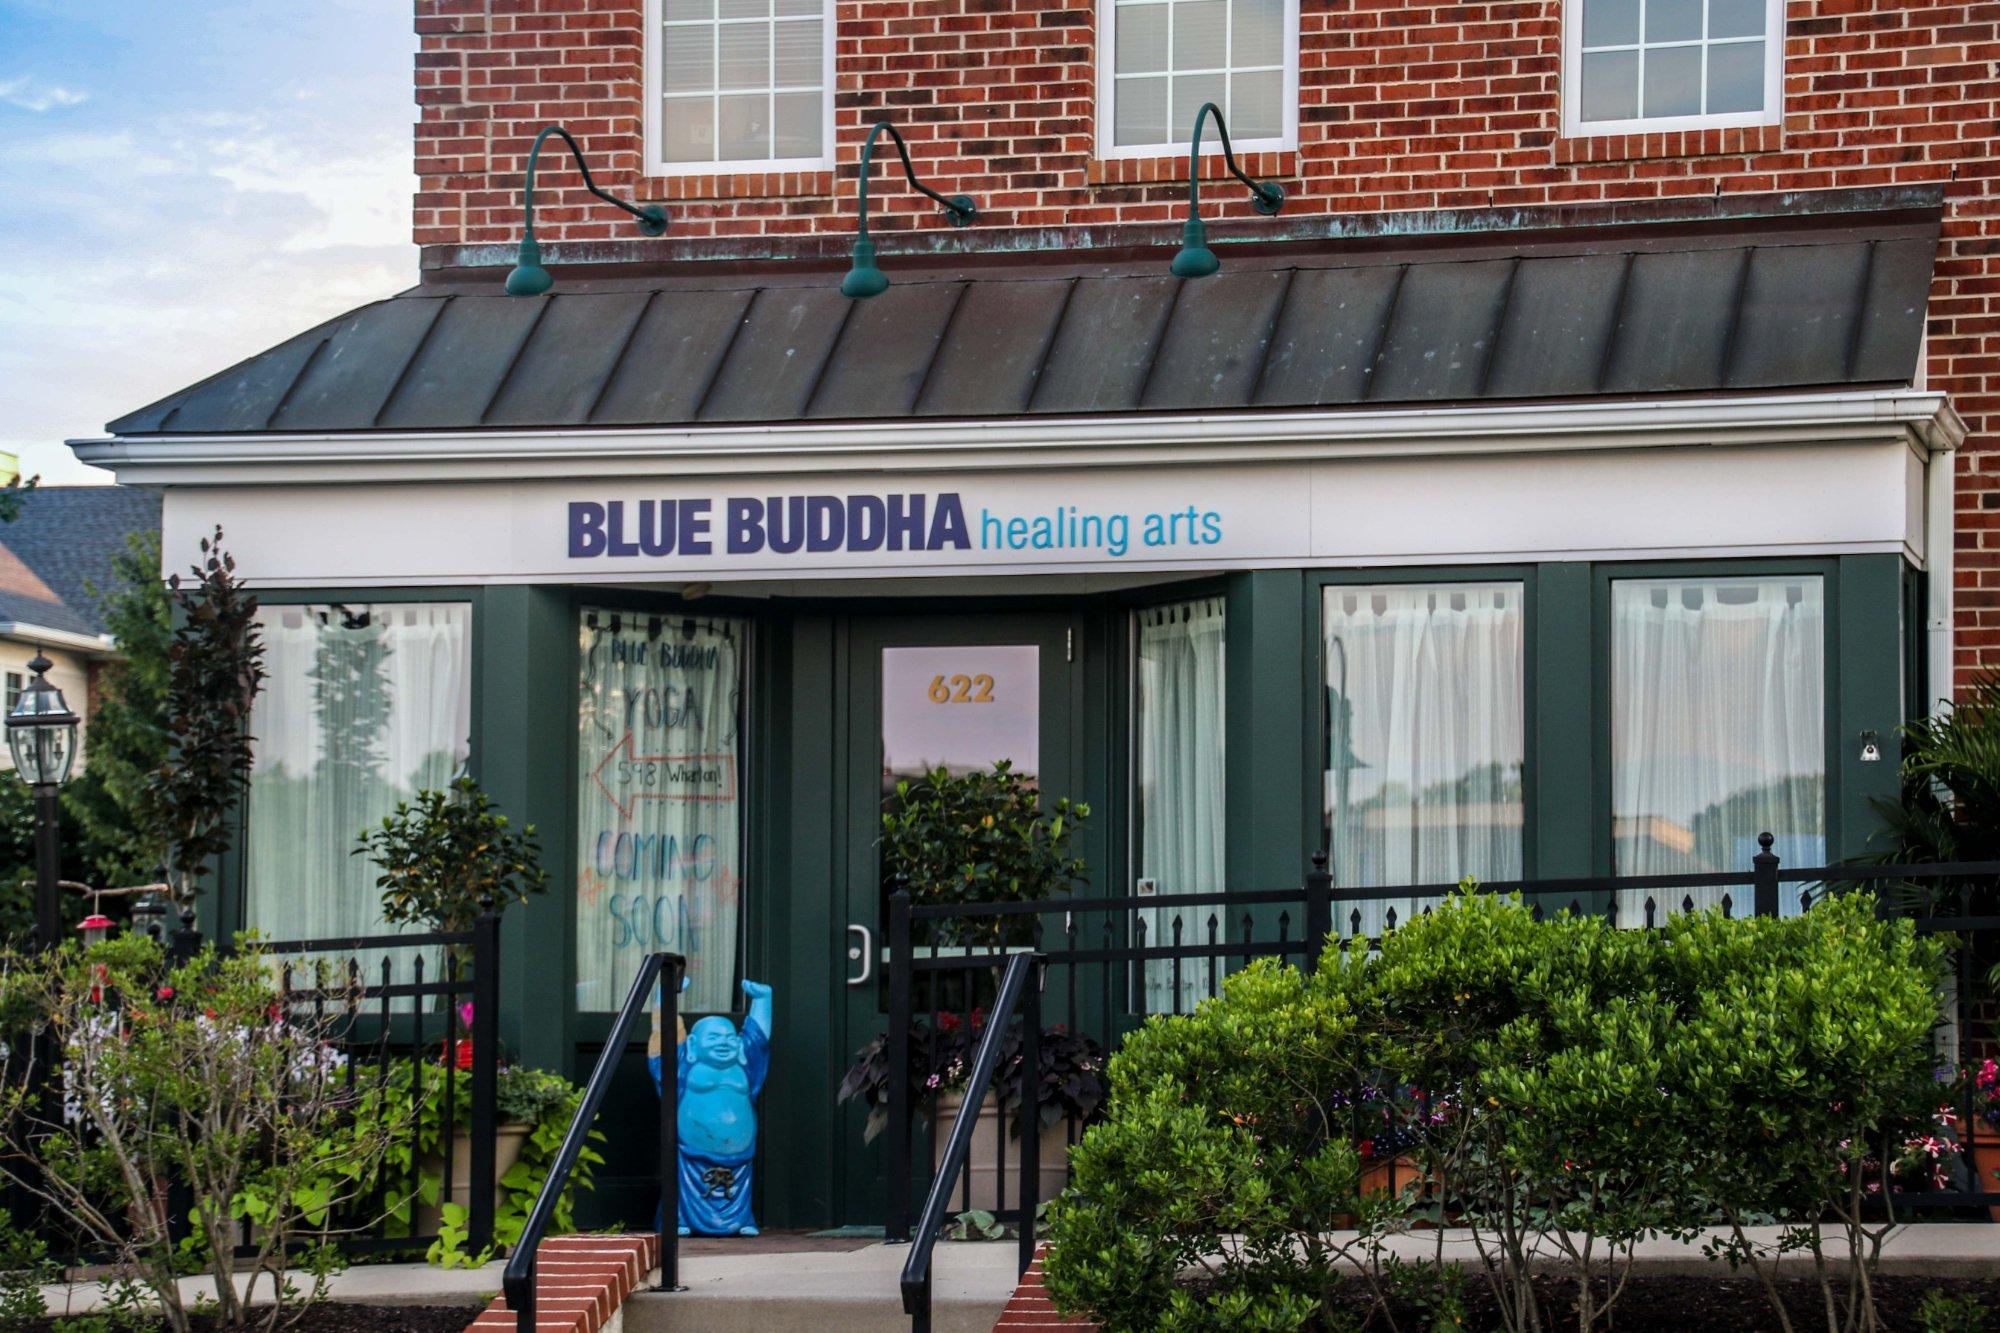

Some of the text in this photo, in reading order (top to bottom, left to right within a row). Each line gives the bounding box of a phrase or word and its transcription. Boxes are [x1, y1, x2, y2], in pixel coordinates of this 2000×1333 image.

[568, 493, 1222, 558] BLUE BUDDHA healing arts
[623, 685, 704, 732] YOGA
[928, 673, 995, 704] 622
[618, 760, 657, 787] 598
[597, 829, 717, 881] COMING
[609, 894, 700, 952] SOON
